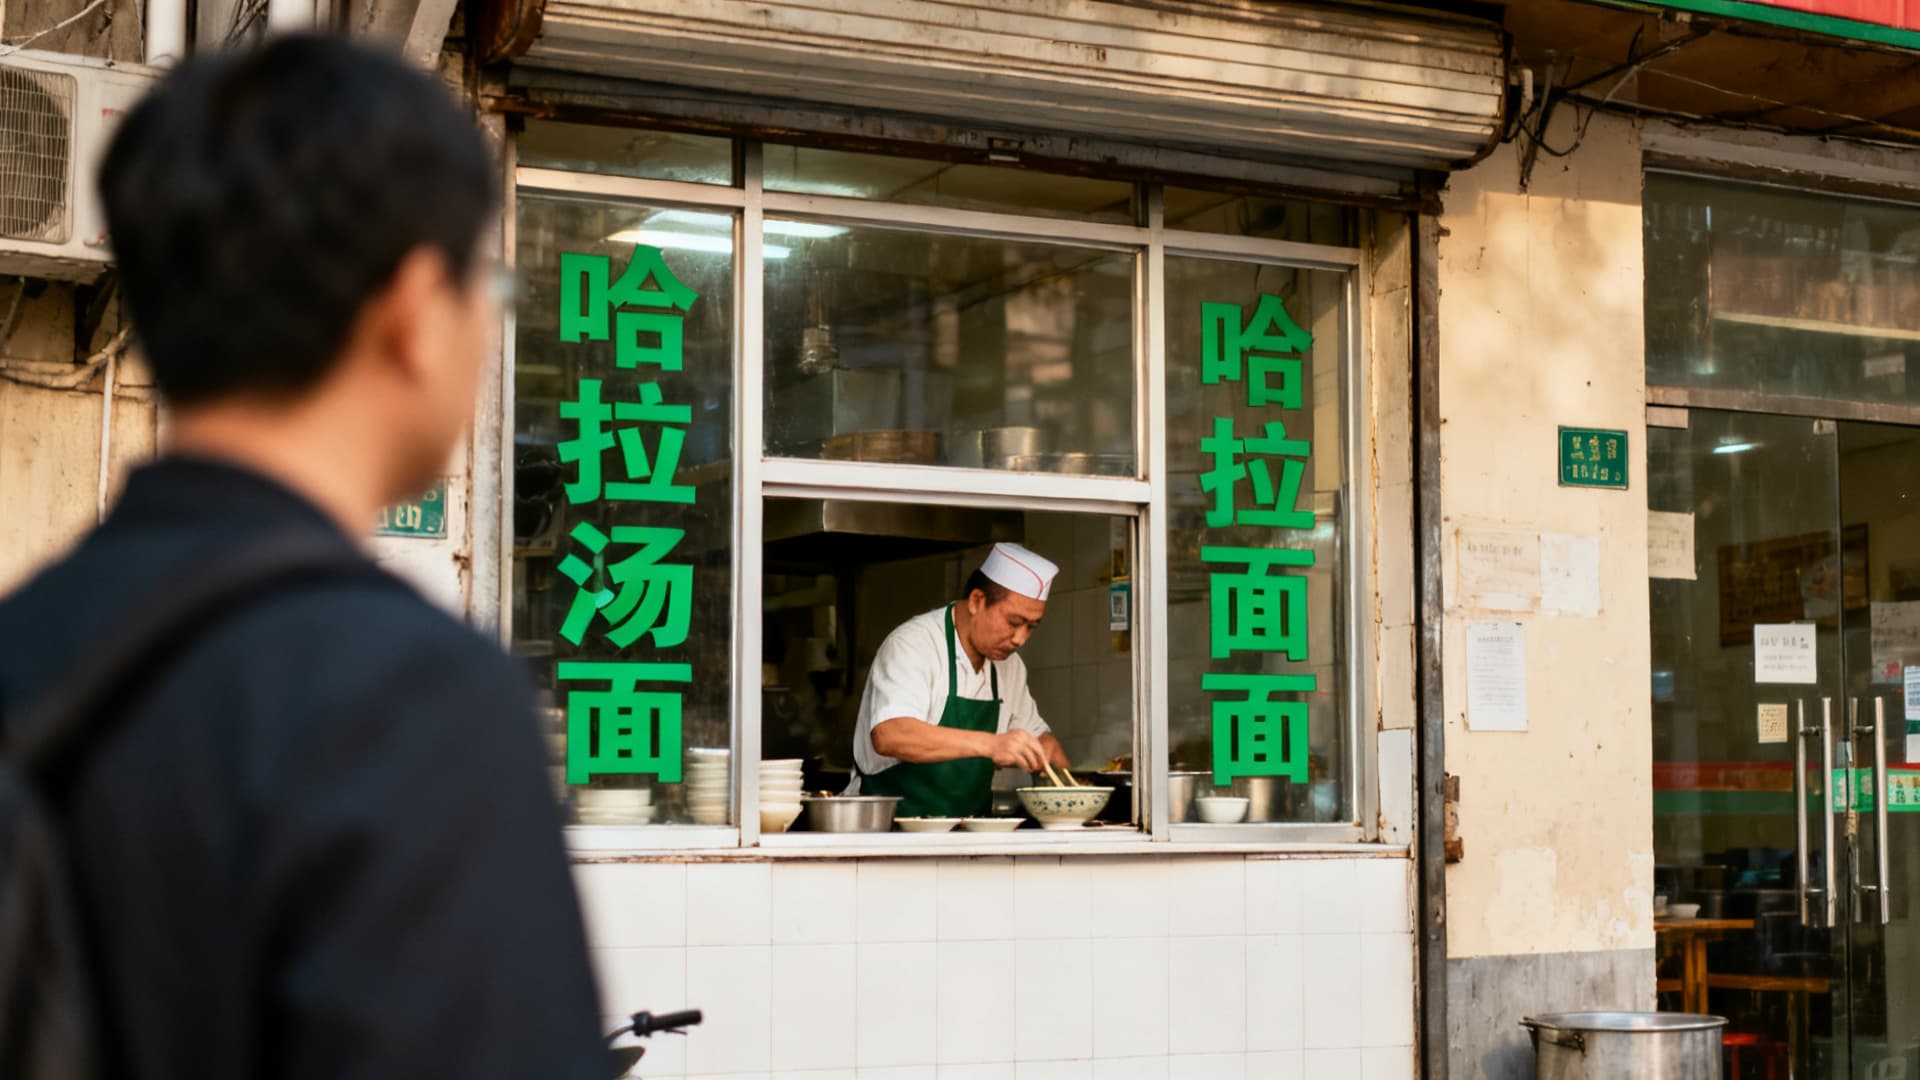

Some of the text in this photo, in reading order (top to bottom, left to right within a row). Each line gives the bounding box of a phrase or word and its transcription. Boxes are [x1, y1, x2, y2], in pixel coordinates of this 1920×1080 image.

[557, 243, 699, 785] 哈拉汤面
[1199, 293, 1317, 786] 哈拉面面
